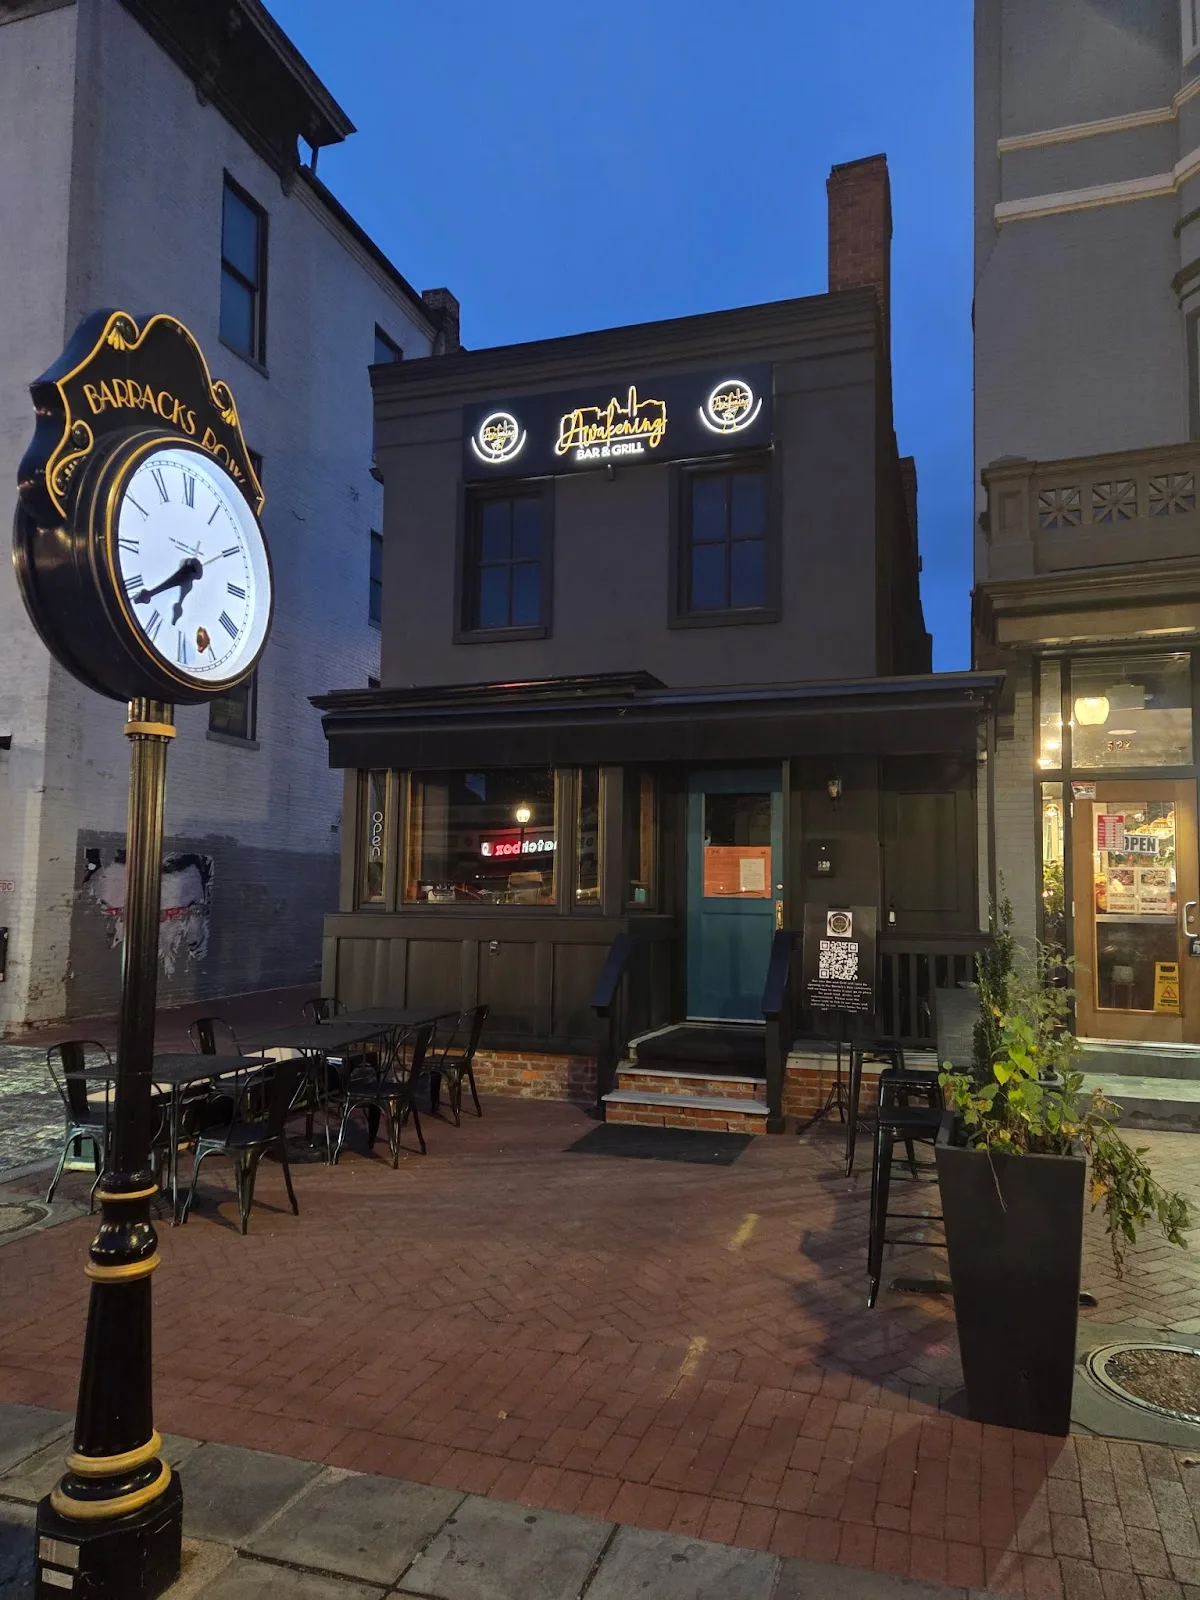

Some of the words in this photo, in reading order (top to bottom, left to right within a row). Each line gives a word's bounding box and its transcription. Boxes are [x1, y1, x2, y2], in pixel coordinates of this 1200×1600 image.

[83, 378, 196, 435] BARRACKS
[555, 404, 668, 455] Awakening
[576, 448, 600, 460] BAR
[602, 446, 610, 457] &
[611, 442, 645, 455] GRILL
